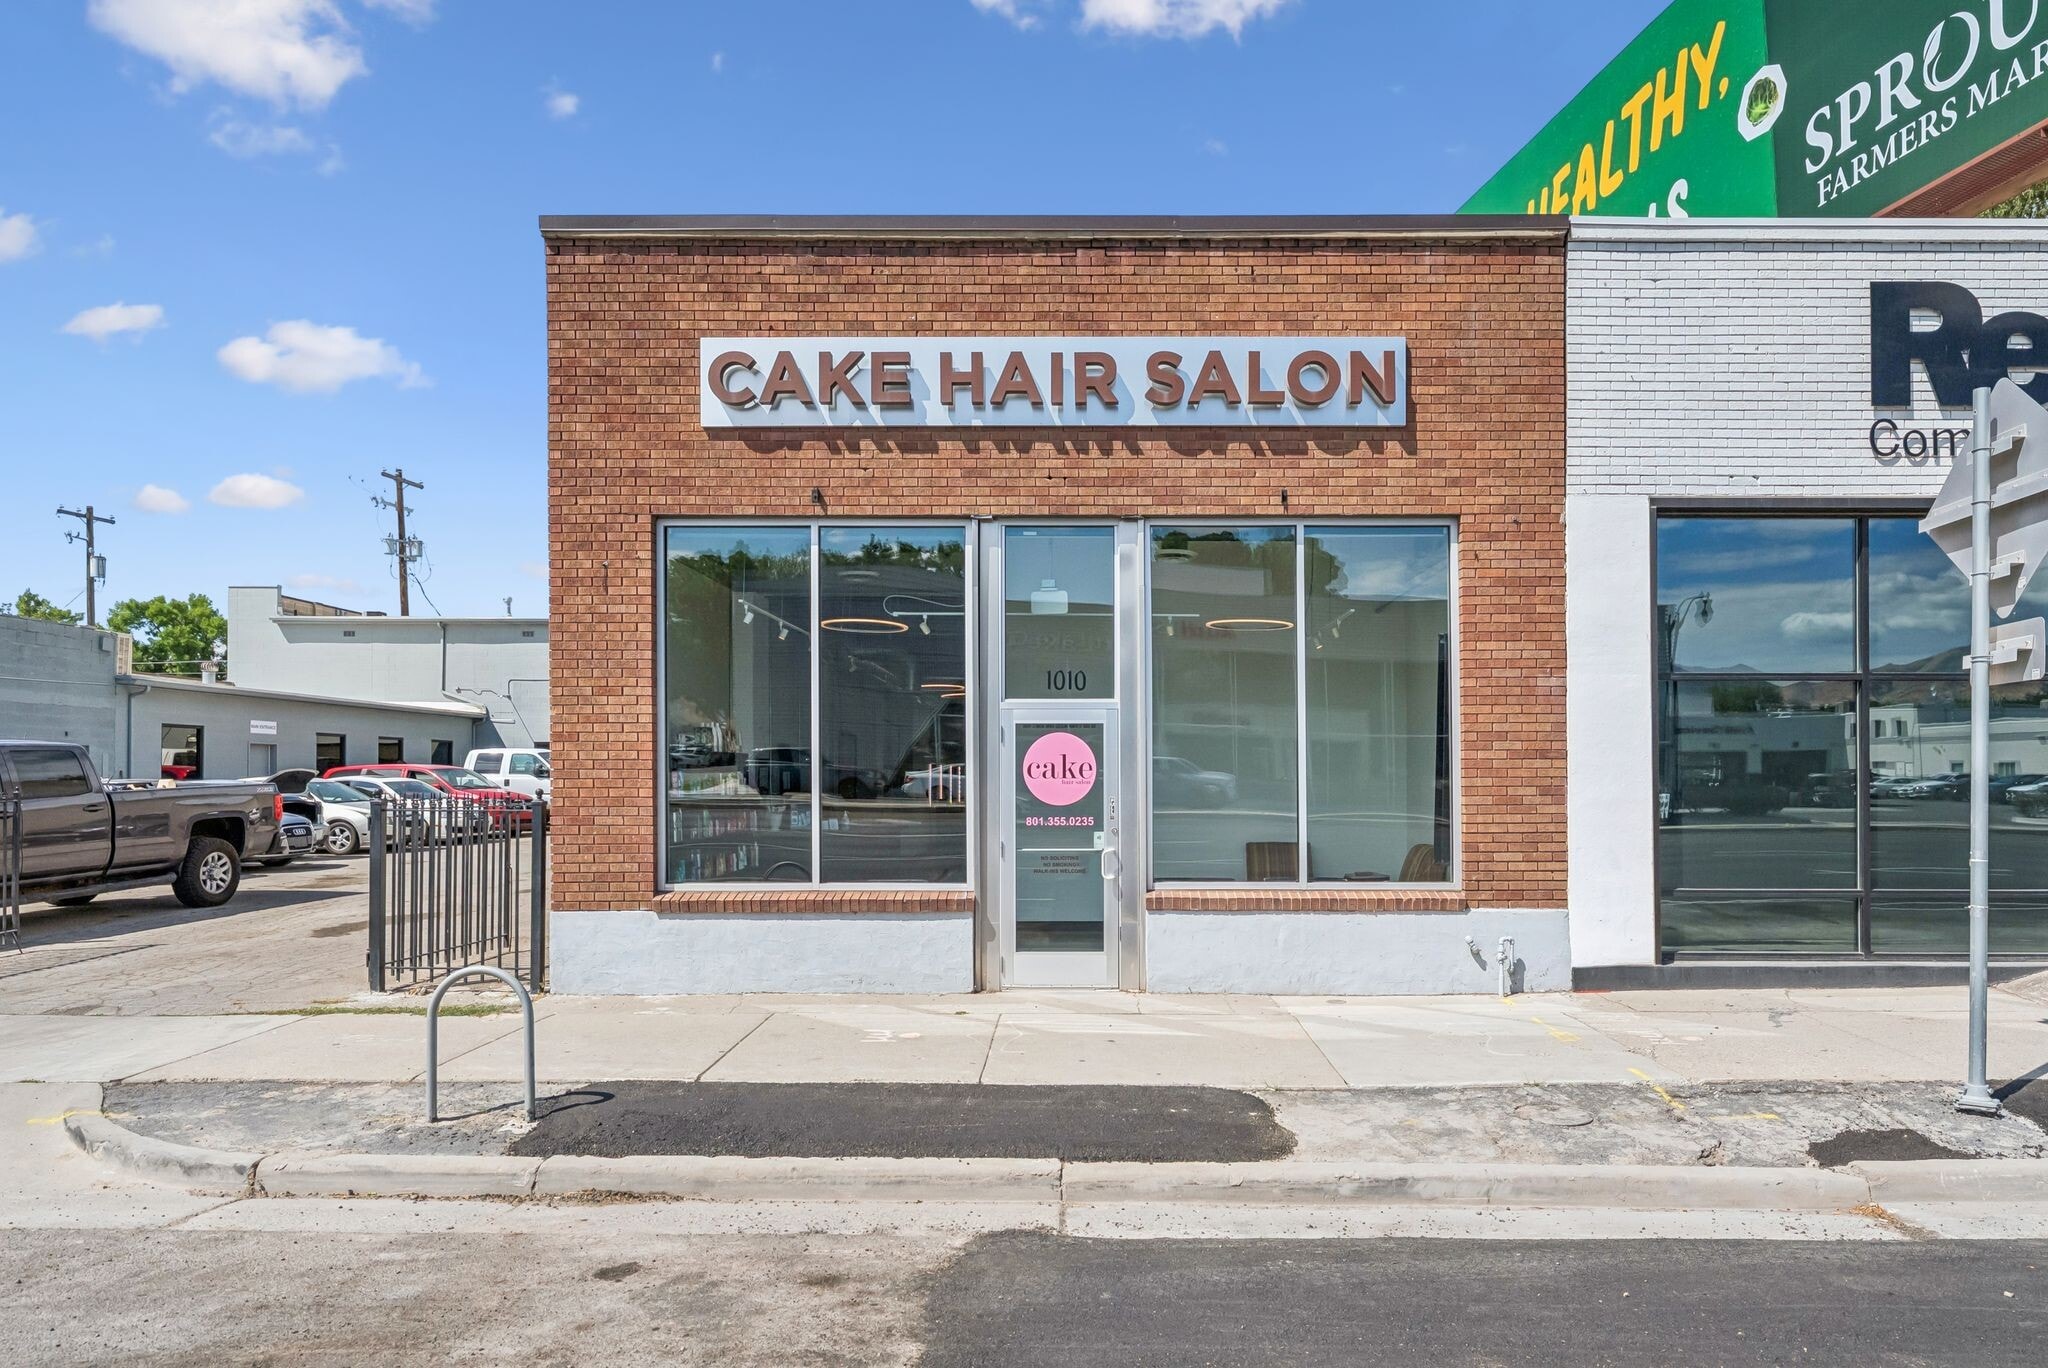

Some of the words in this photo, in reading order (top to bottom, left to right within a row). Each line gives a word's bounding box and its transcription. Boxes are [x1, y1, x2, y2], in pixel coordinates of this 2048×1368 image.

[1528, 20, 1729, 215] EALTHY,
[1817, 97, 1957, 208] FARMERS
[707, 350, 913, 408] CAKE
[939, 350, 1119, 406] HAIR
[1144, 350, 1396, 408] SALON
[1047, 670, 1087, 691] 1010
[1027, 754, 1094, 779] cake
[1025, 816, 1095, 826] 801.355.0235
